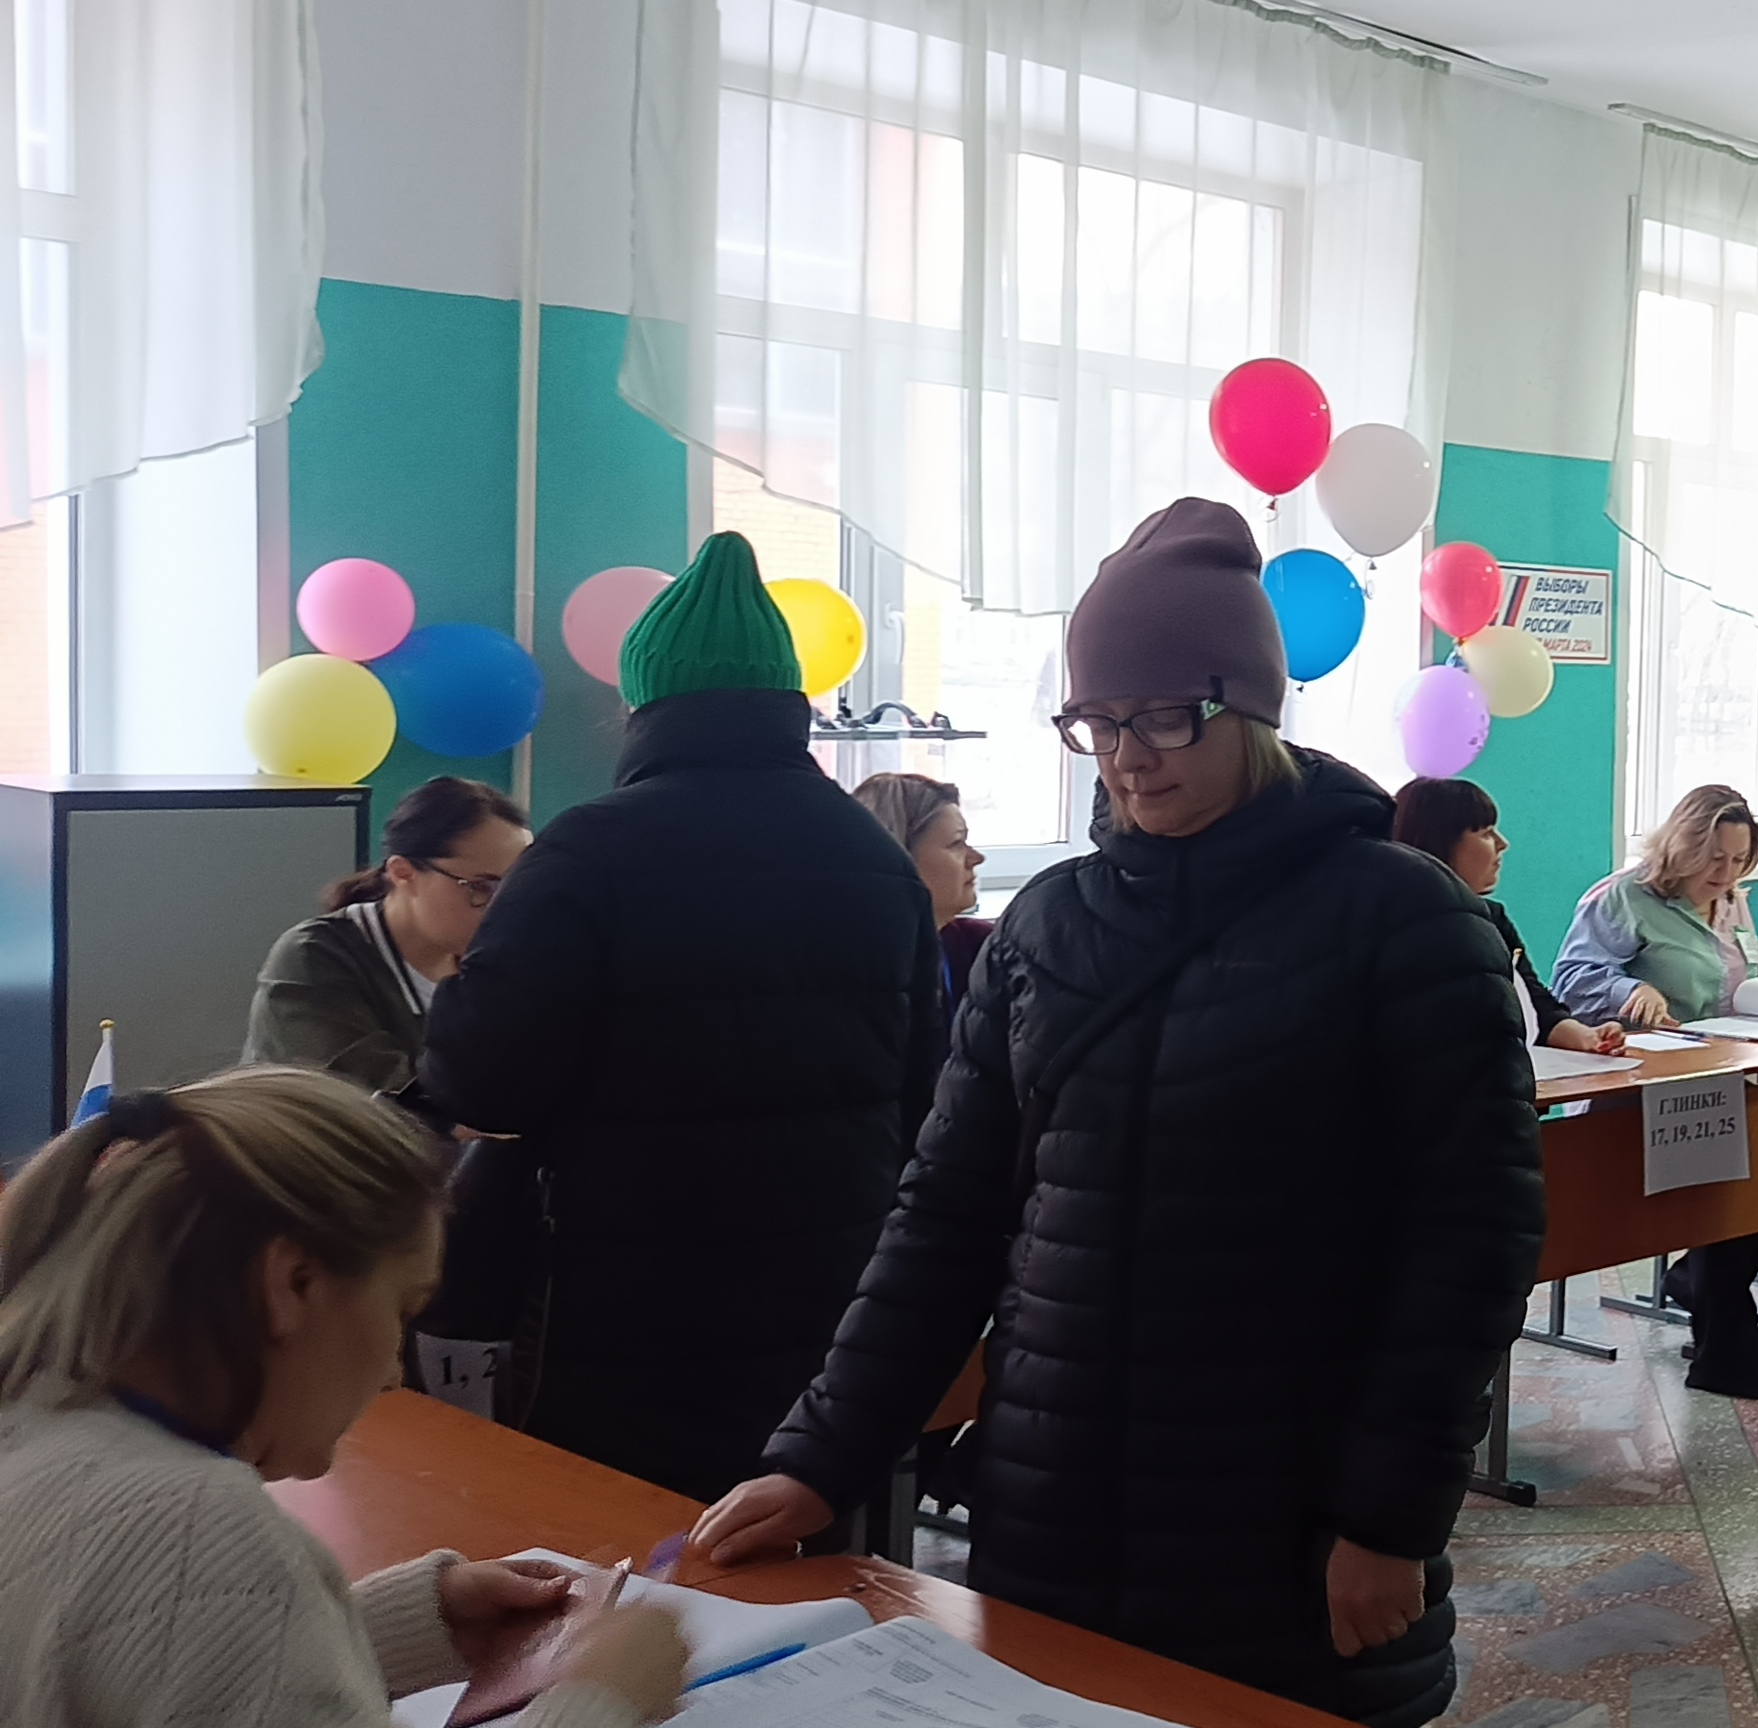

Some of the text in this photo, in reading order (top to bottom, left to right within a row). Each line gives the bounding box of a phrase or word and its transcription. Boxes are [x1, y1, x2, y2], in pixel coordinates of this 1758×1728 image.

[1535, 577, 1589, 594] ВЫБОРЫ
[1528, 597, 1604, 615] ПРЕЗИДЕНТА
[1522, 617, 1572, 634] РОССИИ
[1659, 1091, 1727, 1115] ГЛИНКИ:
[1650, 1117, 1736, 1147] 17, 19, 21, 25
